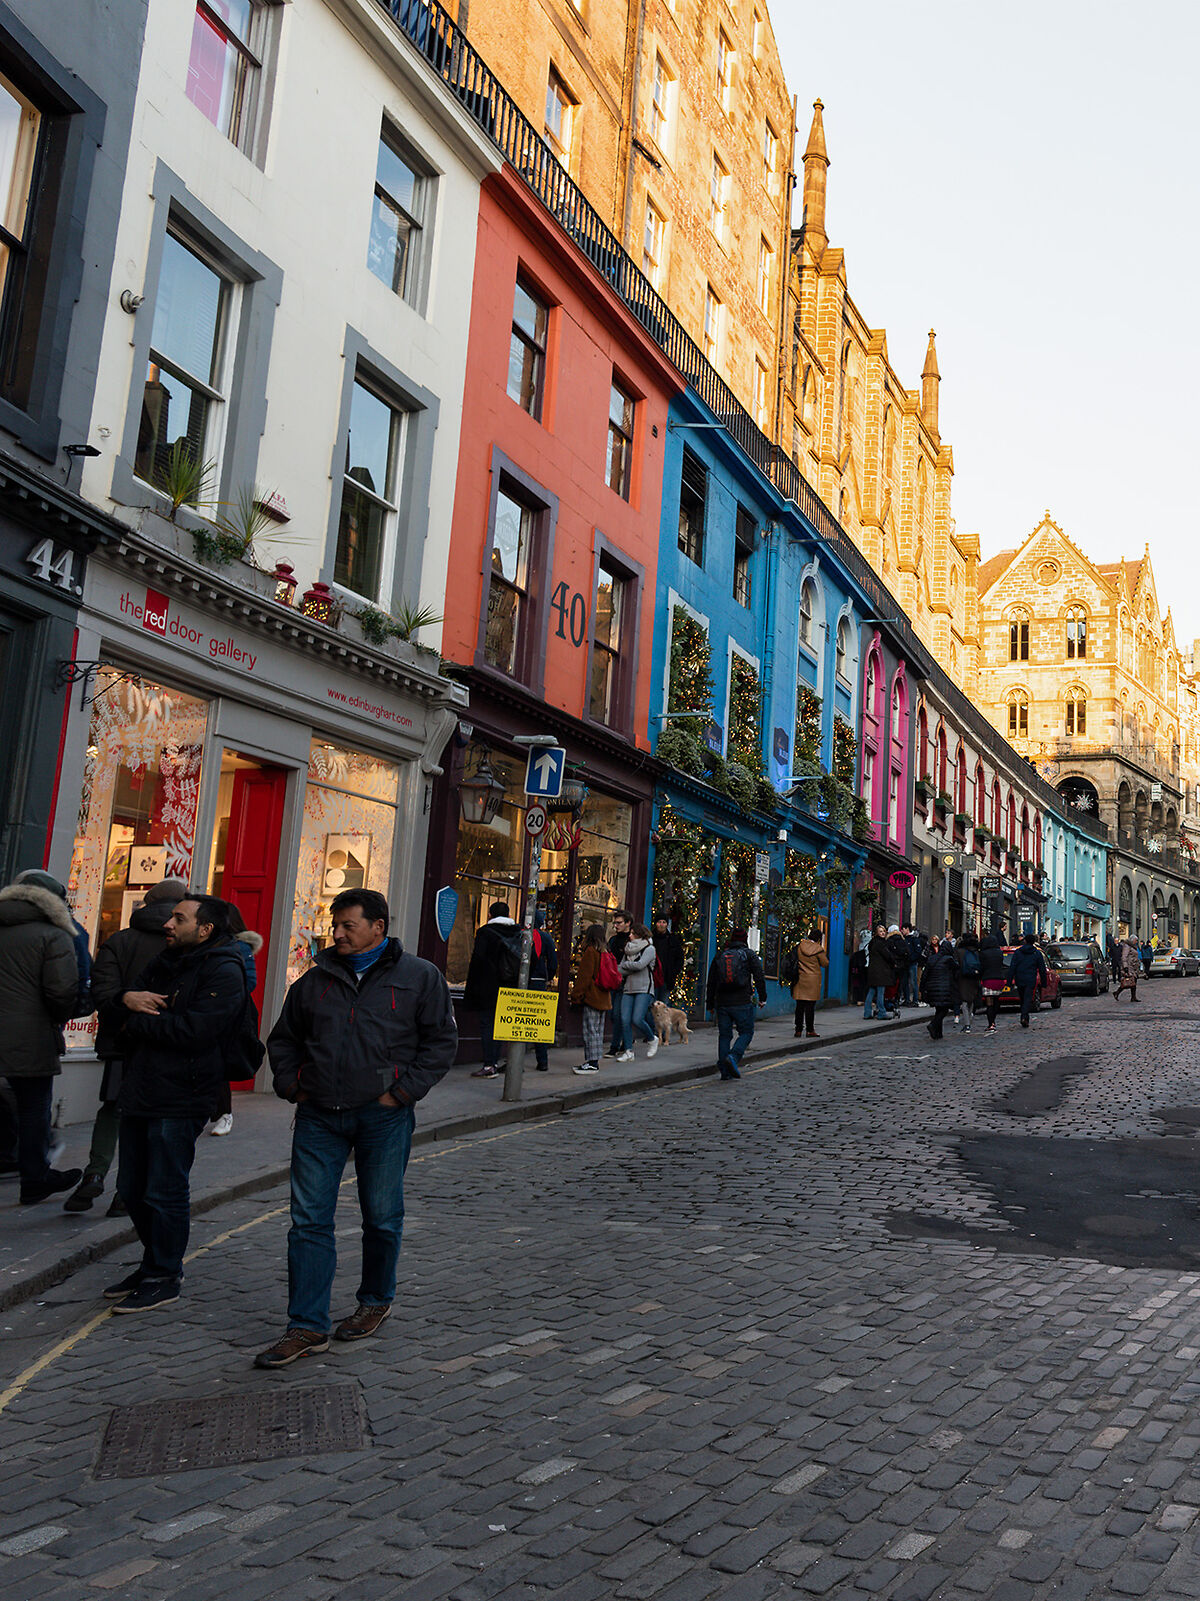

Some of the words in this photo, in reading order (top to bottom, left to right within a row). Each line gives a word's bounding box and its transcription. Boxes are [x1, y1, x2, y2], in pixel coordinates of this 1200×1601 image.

[551, 581, 586, 648] 40
[145, 609, 168, 630] red
[169, 616, 204, 644] door
[208, 638, 257, 670] gallery
[327, 687, 413, 728] www.edinburghart.com
[527, 814, 544, 828] 20
[500, 990, 525, 998] PARKING
[525, 993, 558, 1001] SUSPENDED
[500, 1016, 513, 1024] NO
[514, 1017, 551, 1027] PARKING
